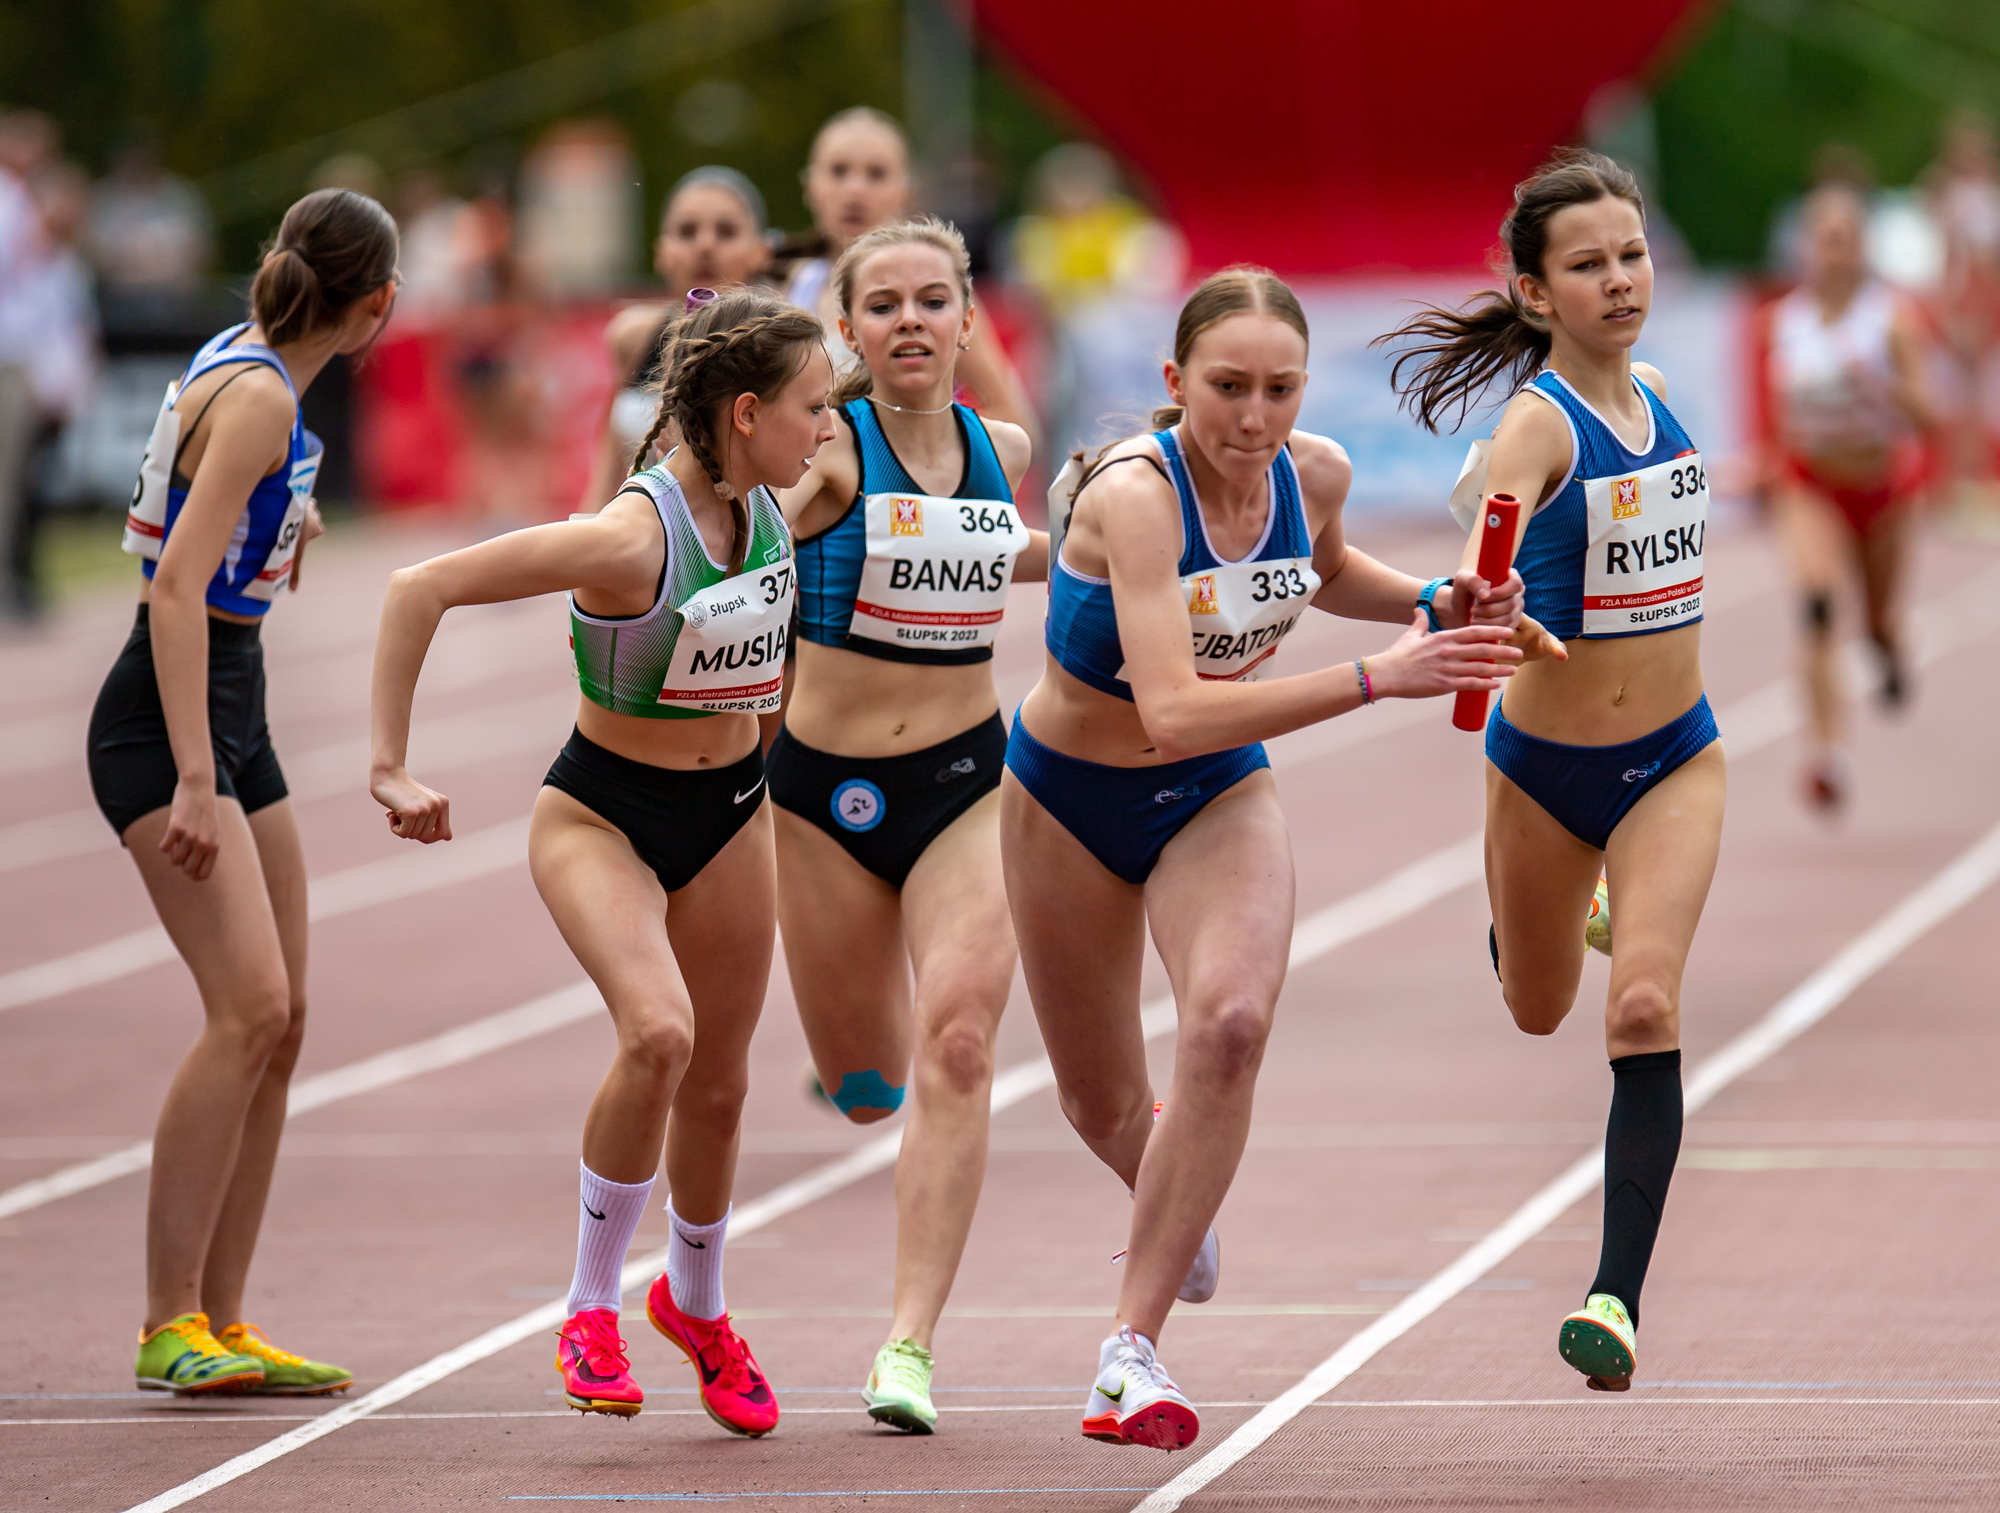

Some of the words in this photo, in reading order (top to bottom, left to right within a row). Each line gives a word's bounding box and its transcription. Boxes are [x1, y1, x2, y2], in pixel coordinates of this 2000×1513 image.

[959, 506, 1013, 534] 364
[1614, 502, 1640, 518] PZLA
[891, 523, 922, 535] PZLA
[889, 553, 1006, 592] BANAŚ
[1251, 568, 1307, 602] 333
[710, 595, 747, 617] Słupsk
[1600, 598, 1620, 607] PZLA
[1622, 592, 1667, 606] Mistrzostwa
[1667, 586, 1686, 598] Polski
[1630, 605, 1678, 623] SŁUPSK
[1680, 597, 1700, 614] 2023
[896, 628, 947, 641] SŁUPSK
[950, 629, 979, 641] 2023
[689, 623, 786, 675] MUSIA
[697, 690, 746, 699] Mistrzostwa
[747, 684, 770, 695] Polski
[701, 700, 756, 711] SŁUPSK
